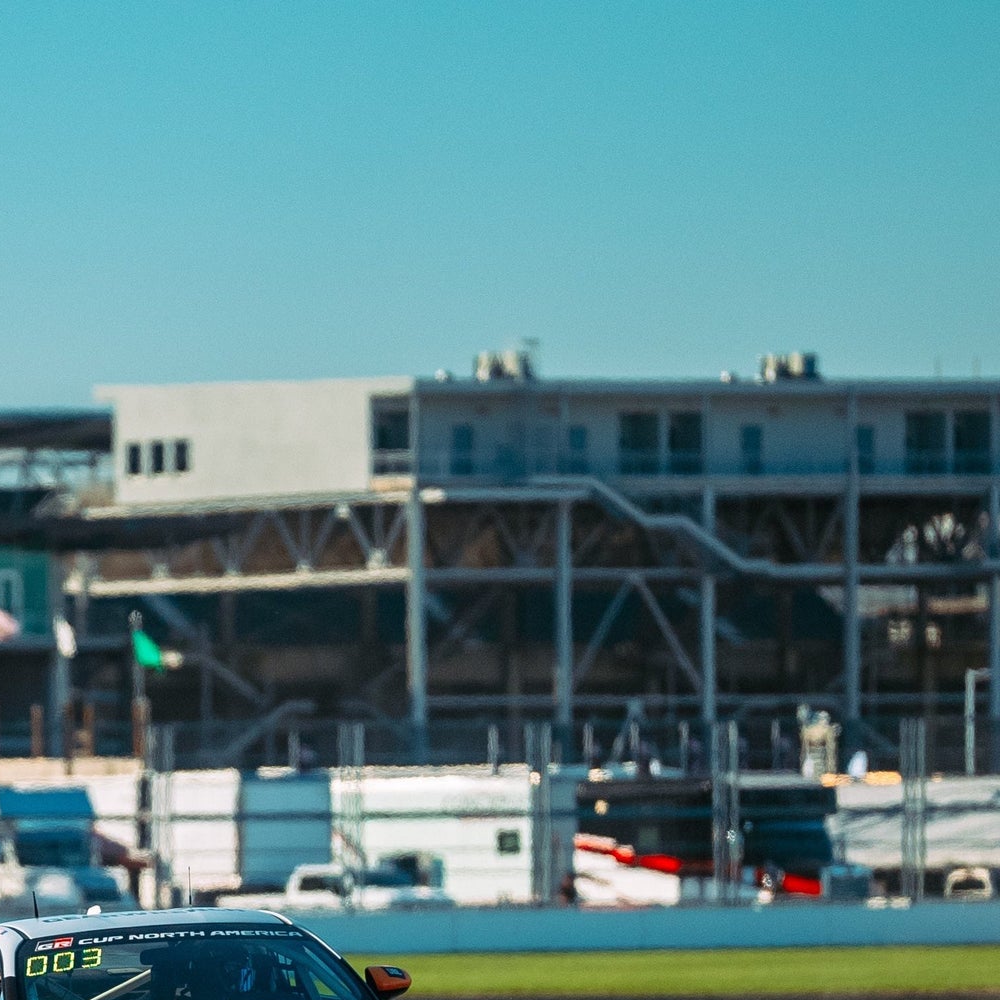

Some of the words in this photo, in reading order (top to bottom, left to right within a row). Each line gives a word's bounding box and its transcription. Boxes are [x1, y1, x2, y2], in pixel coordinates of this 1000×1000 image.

[78, 935, 124, 945] CUP
[128, 930, 205, 940] NORTH
[26, 948, 102, 977] 003
